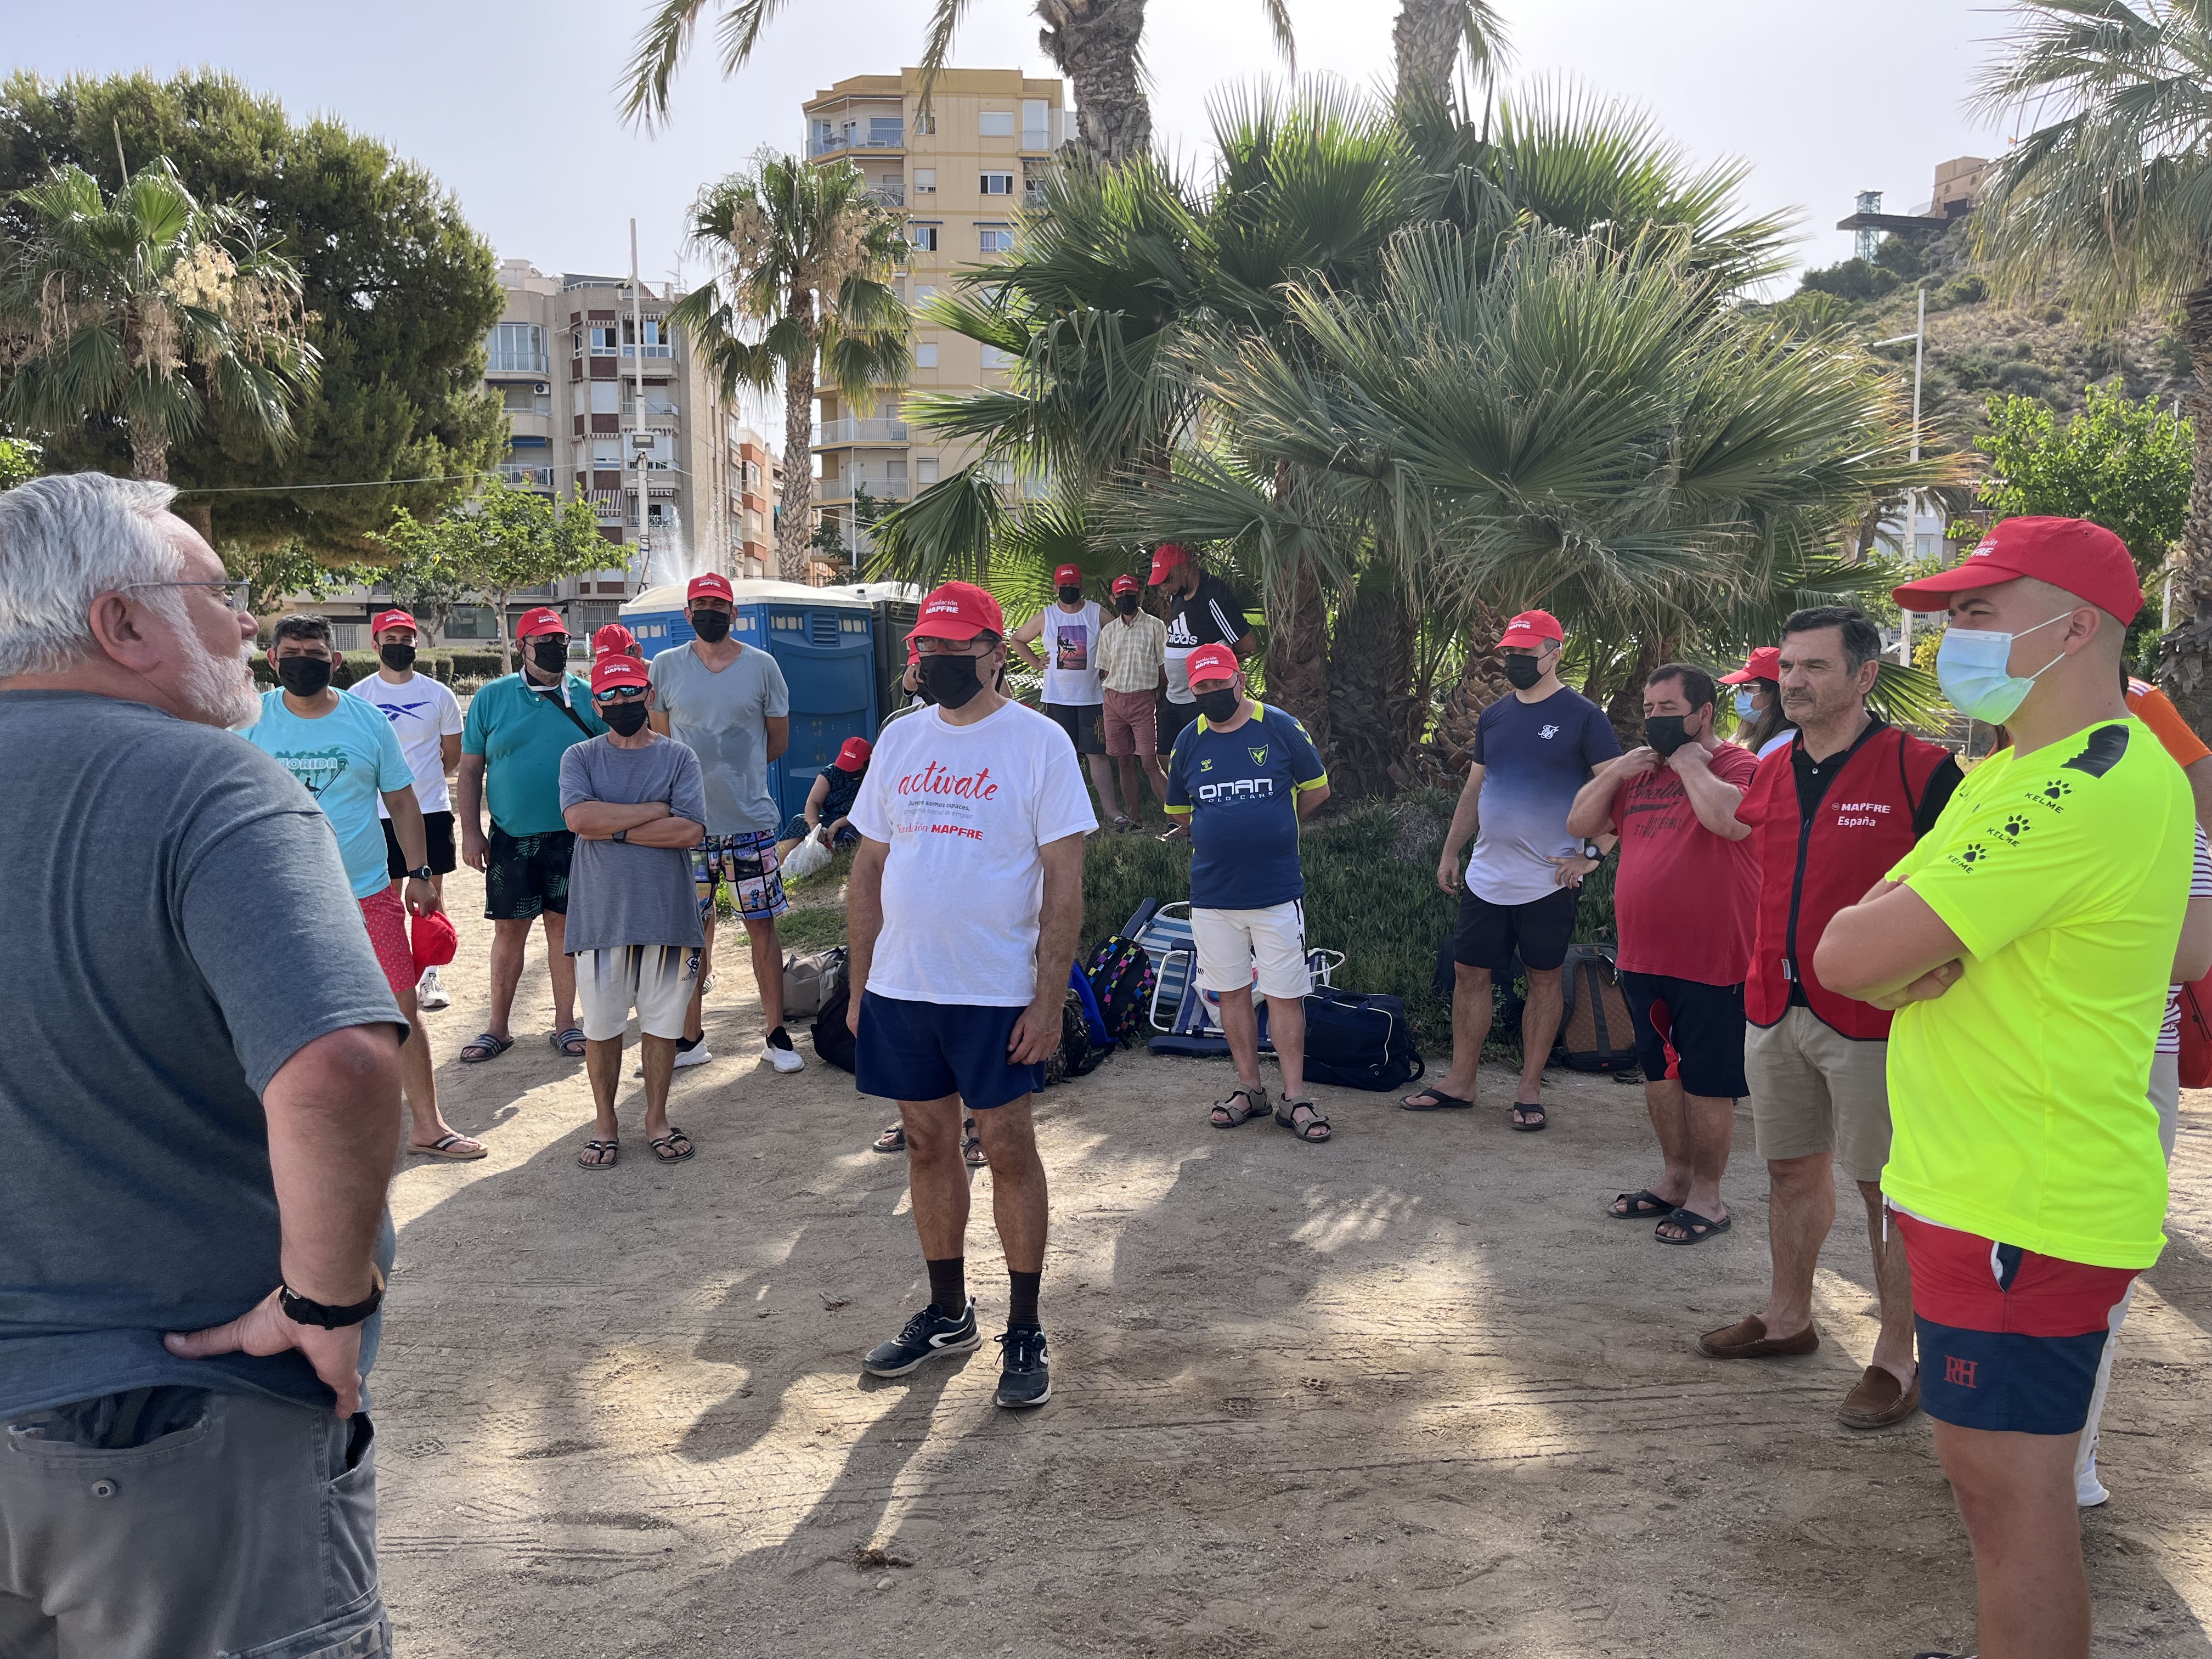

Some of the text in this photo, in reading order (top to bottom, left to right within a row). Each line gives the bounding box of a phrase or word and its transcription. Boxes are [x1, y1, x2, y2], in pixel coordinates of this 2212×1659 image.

[926, 606, 959, 614] MAPFRE
[1195, 660, 1219, 669] MAPFRE
[898, 760, 998, 800] actívate
[1240, 792, 1273, 800] CARS
[1841, 803, 1891, 814] MAPFRE
[2024, 792, 2064, 814] KELME
[951, 811, 973, 820] empleo
[1837, 816, 1876, 828] España
[930, 824, 984, 841] MAPFRE
[1986, 827, 2021, 848] KELME
